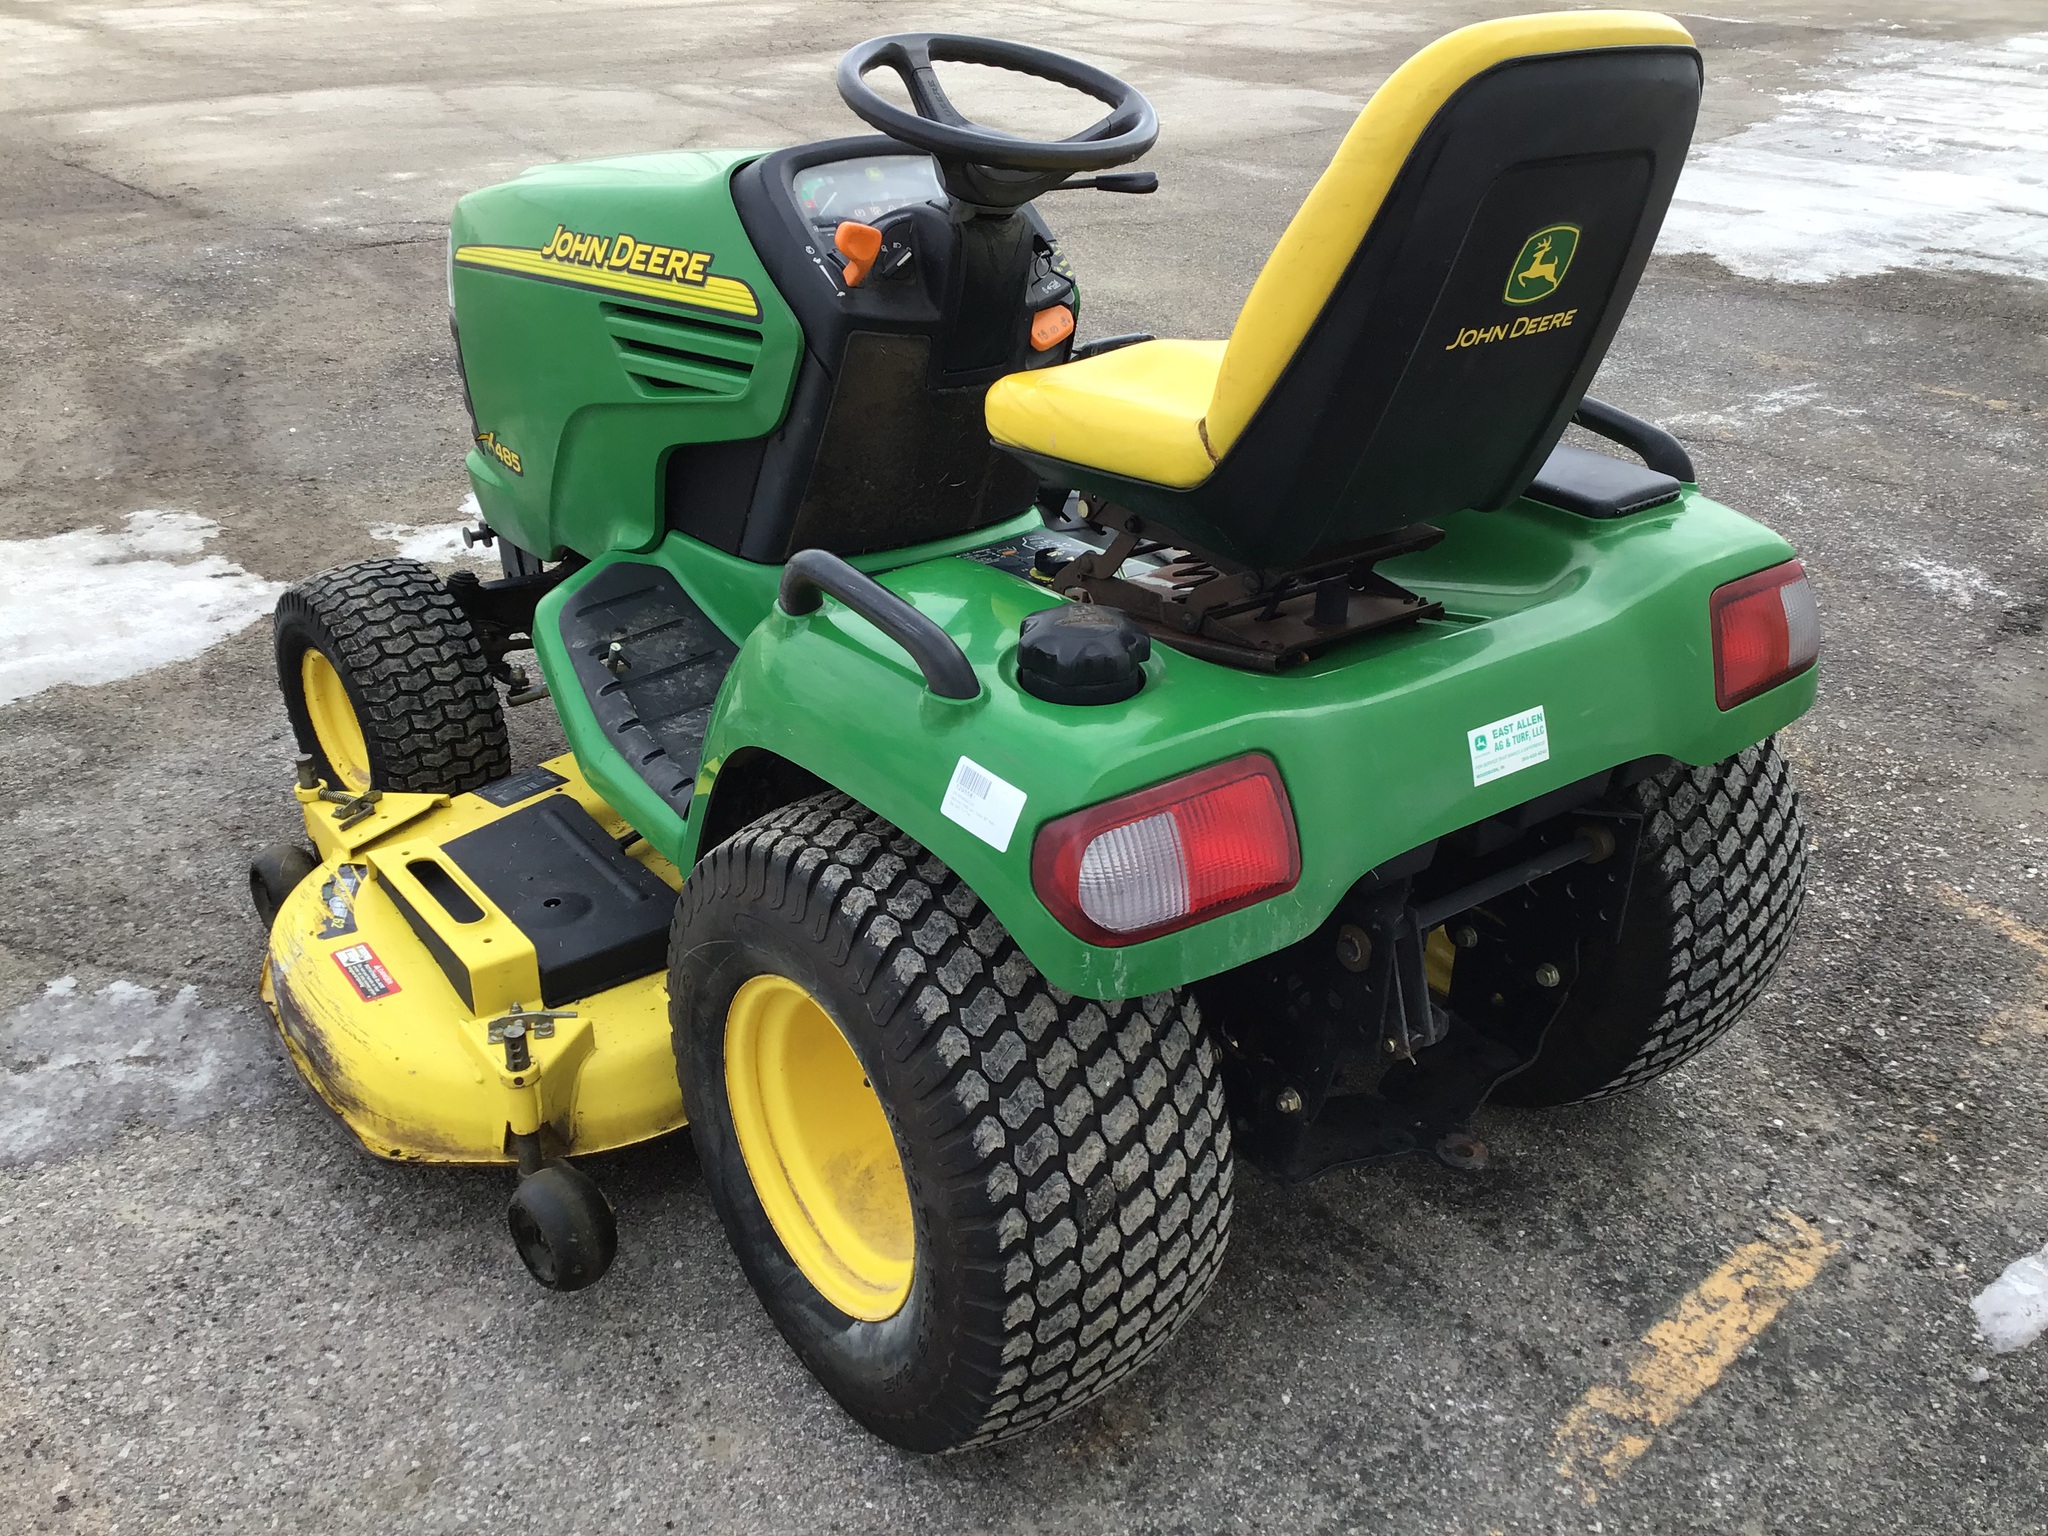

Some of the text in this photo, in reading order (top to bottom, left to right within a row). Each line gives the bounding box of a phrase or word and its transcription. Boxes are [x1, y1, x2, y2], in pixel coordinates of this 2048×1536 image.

[540, 224, 714, 287] JOHN DEERE
[1445, 308, 1578, 351] JOHN DEERE
[1492, 713, 1543, 739] EAST ALLEN
[1494, 726, 1545, 752] AG & TURF, LLC
